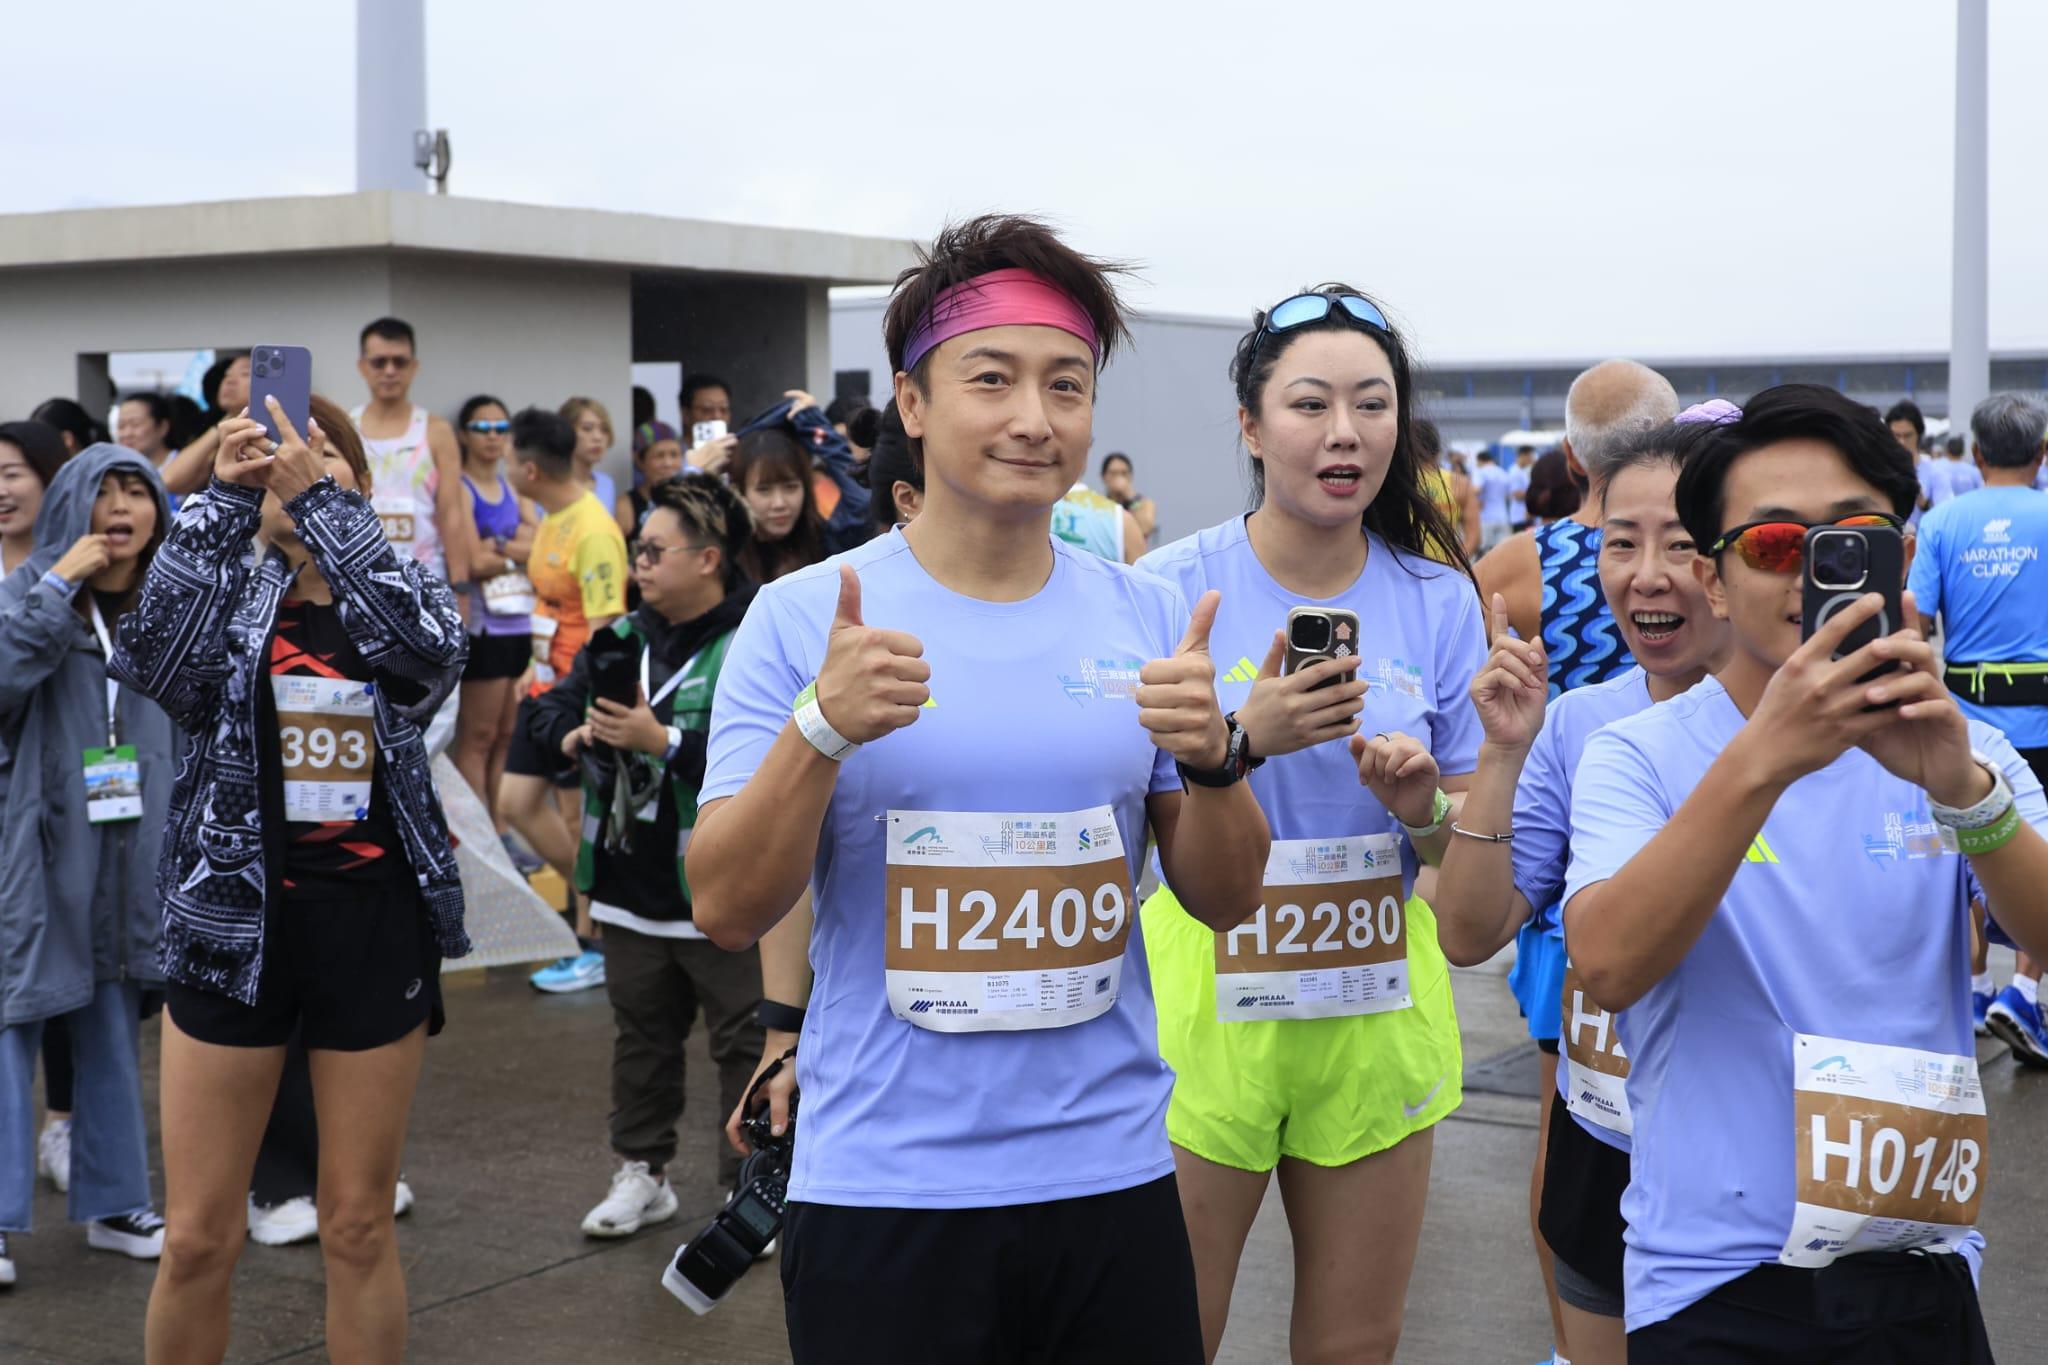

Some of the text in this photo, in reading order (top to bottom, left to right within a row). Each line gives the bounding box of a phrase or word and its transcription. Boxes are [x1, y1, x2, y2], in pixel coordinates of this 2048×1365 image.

[1972, 562, 2020, 577] CLINIC
[1016, 840, 1056, 850] 10公里跑
[901, 882, 1126, 950] H2409
[1227, 895, 1400, 956] H2280
[936, 1000, 968, 1008] HKAAA
[1811, 1114, 1980, 1203] H0148
